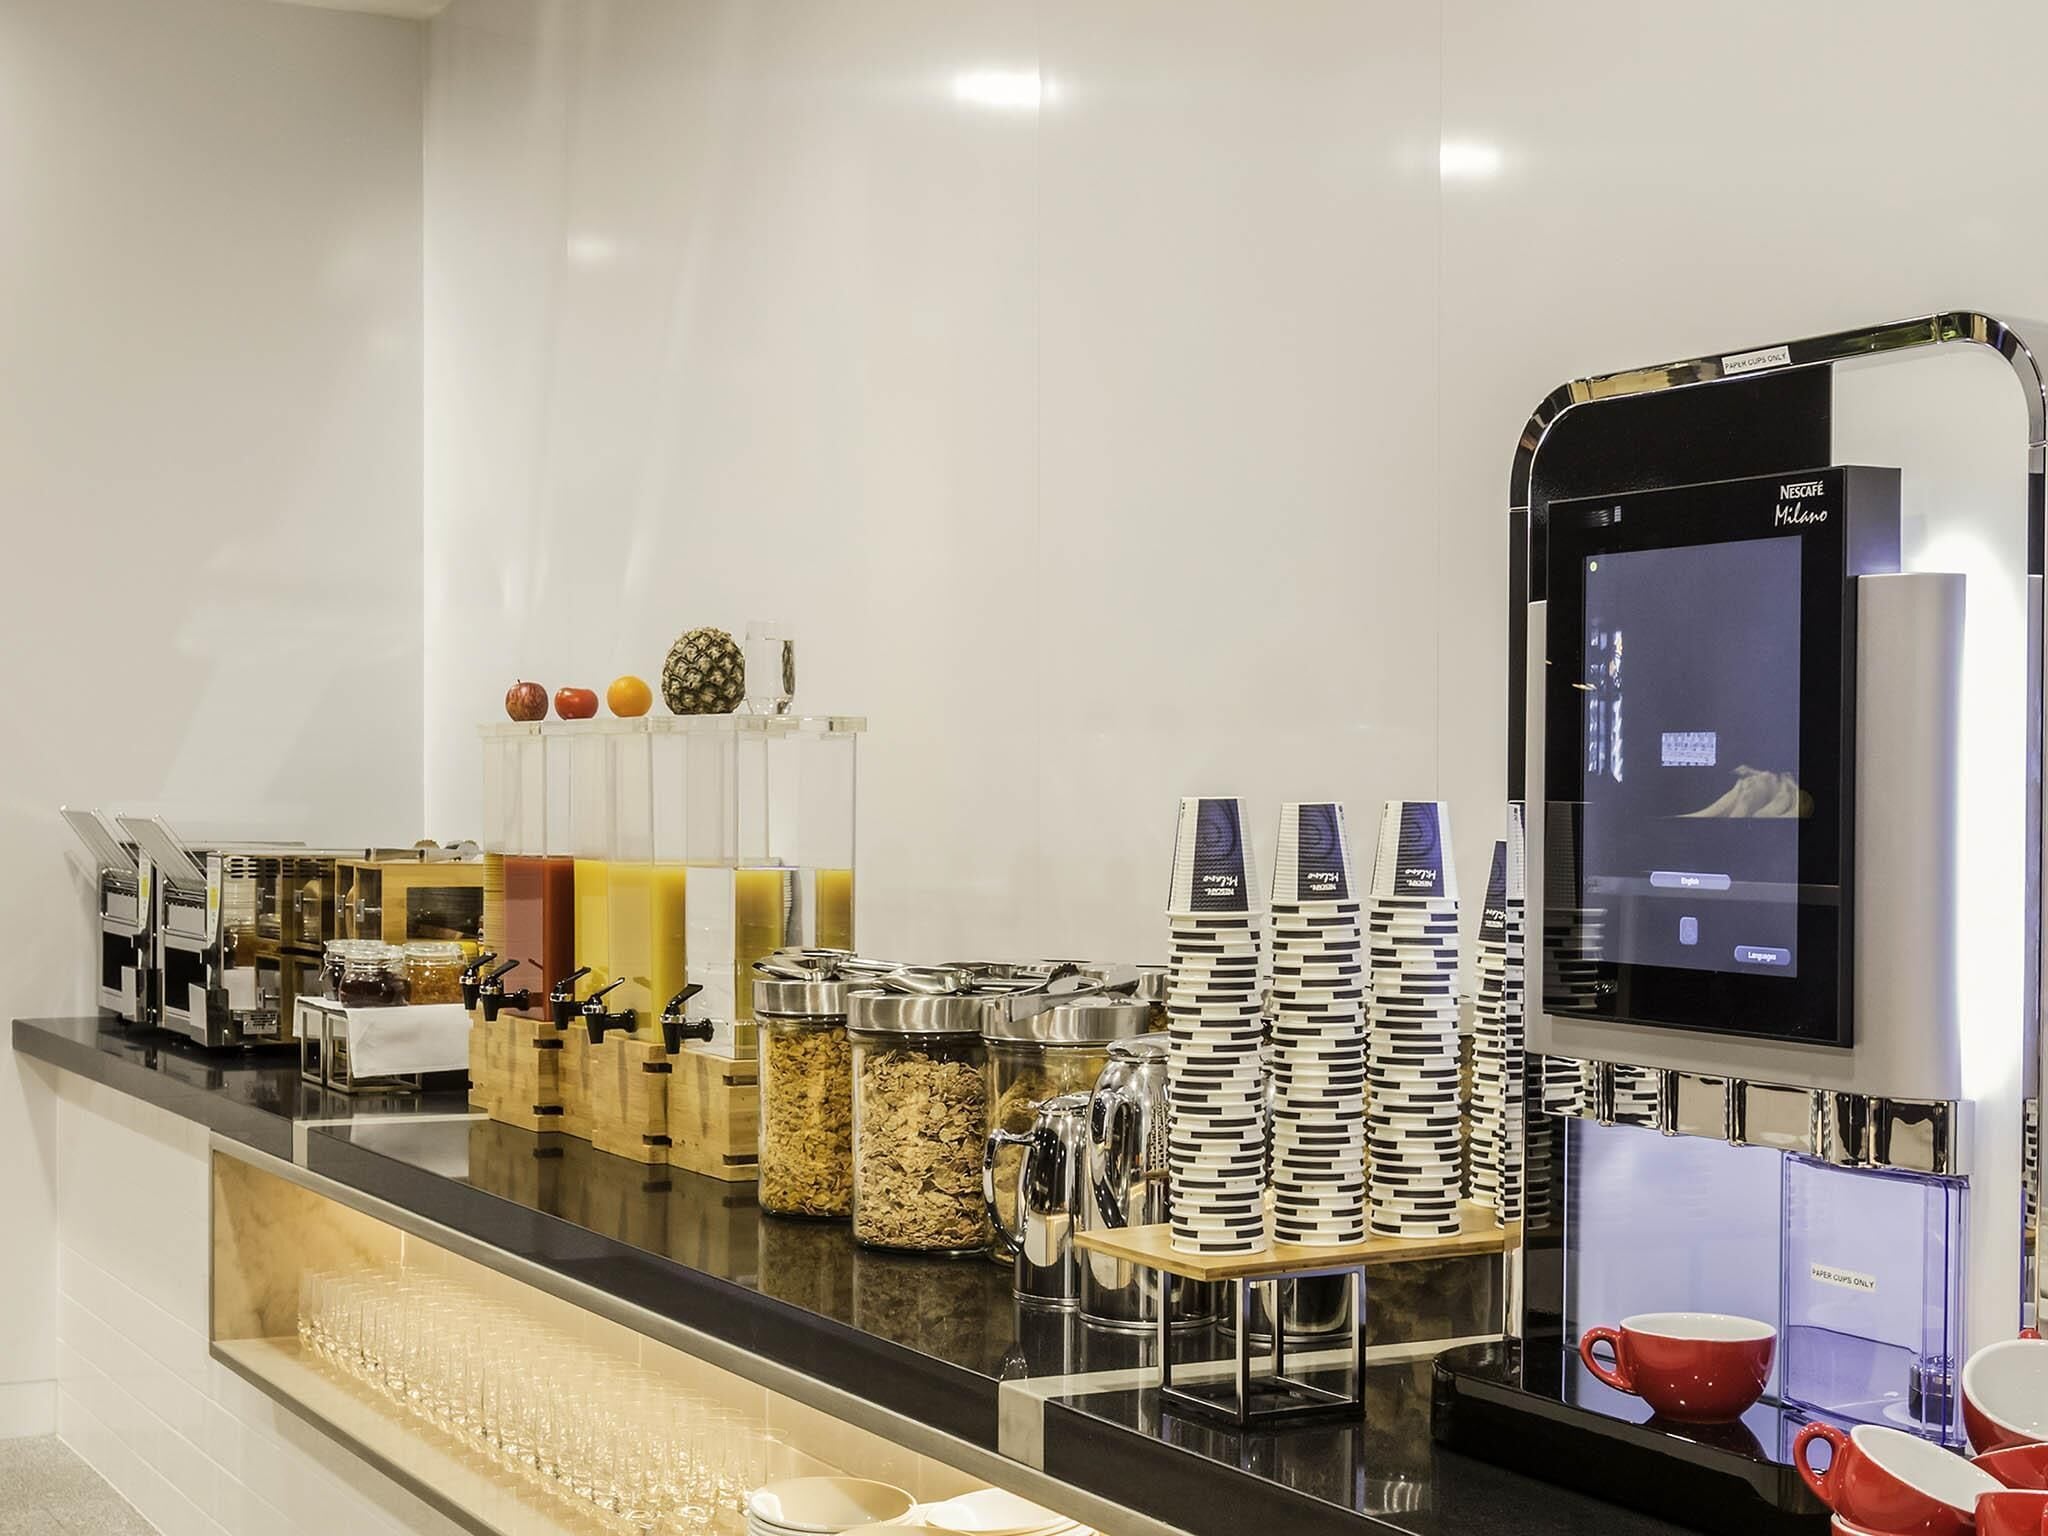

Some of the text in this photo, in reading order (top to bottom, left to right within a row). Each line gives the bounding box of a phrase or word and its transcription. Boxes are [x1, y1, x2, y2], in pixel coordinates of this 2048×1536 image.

[1724, 353, 1787, 369] PAPER CUPS ONLY
[1780, 480, 1824, 500] NESCAFÉ
[1774, 501, 1828, 527] Milano
[1203, 875, 1238, 887] Milano
[1307, 872, 1339, 883] Milano
[1405, 869, 1436, 880] Milano
[1748, 951, 1777, 962] Languages
[1812, 1268, 1875, 1288] PAPER CUPS ONLY
